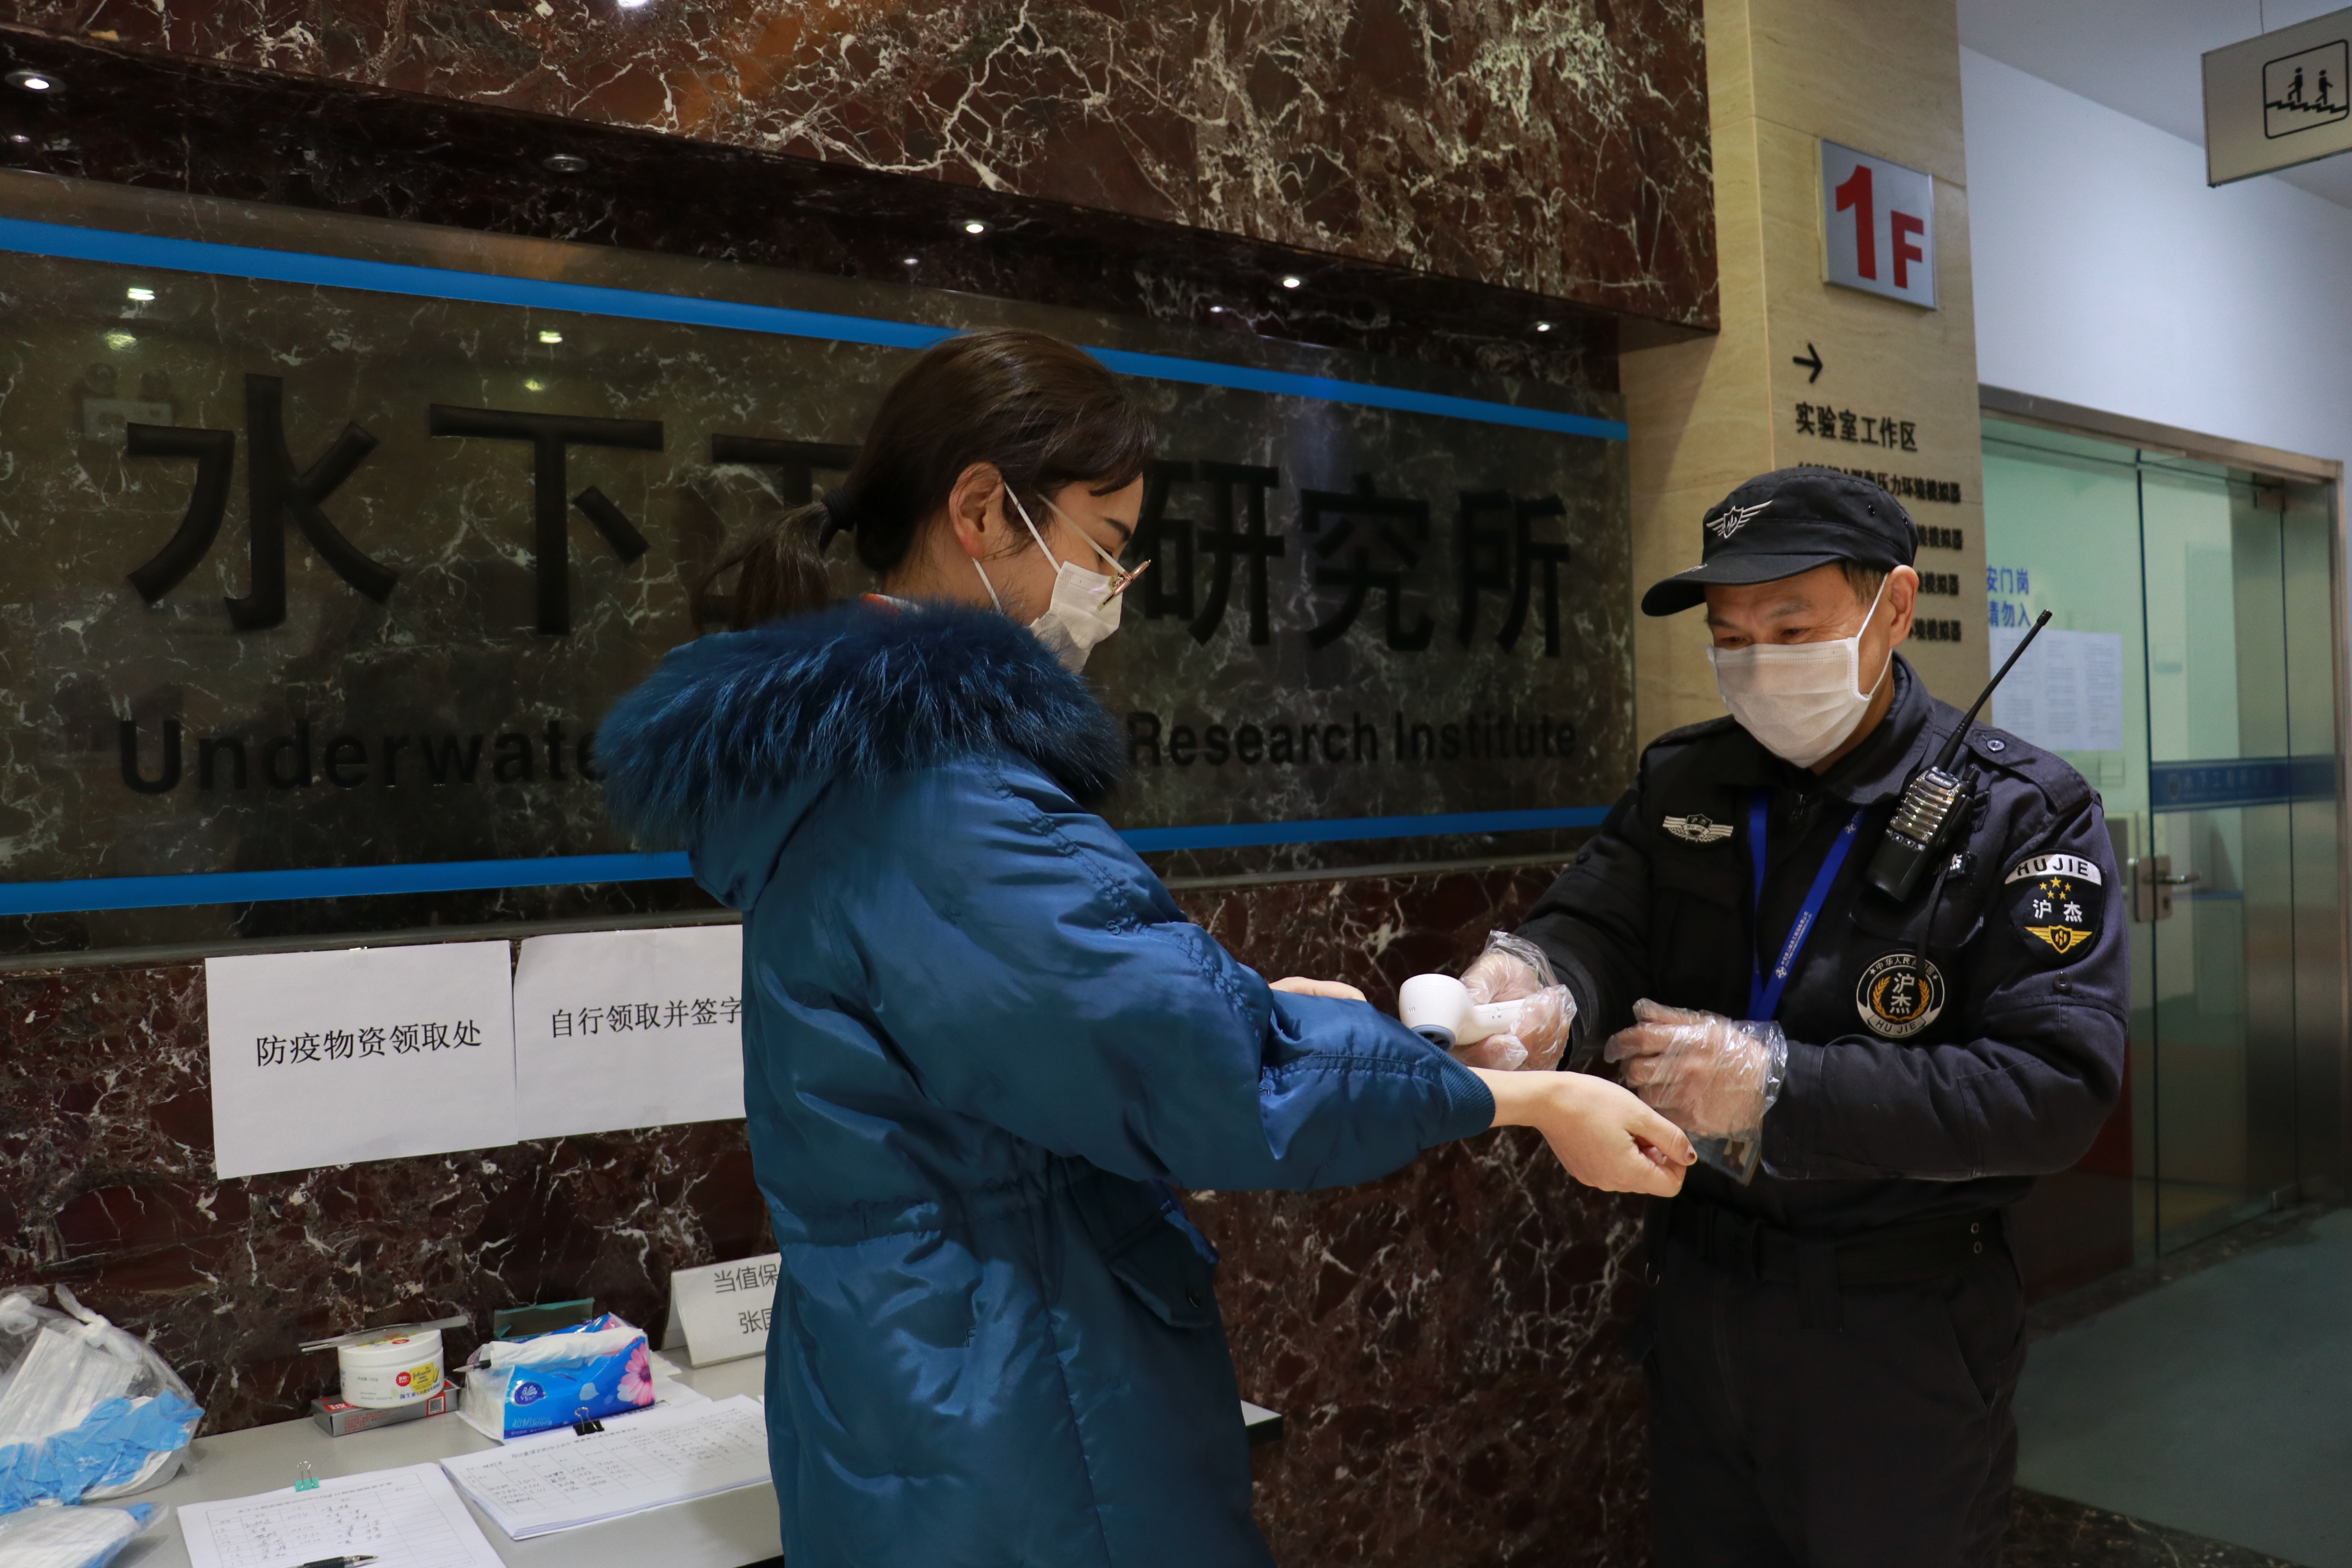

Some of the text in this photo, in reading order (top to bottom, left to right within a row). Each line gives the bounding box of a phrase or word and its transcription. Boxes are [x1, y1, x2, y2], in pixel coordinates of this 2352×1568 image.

[1835, 164, 1925, 289] 1F
[1795, 401, 1918, 452] 实验室工作区
[120, 710, 1577, 796] Underwate Research Institute
[551, 995, 743, 1039] 自行领取并签字
[1889, 972, 1916, 1015] 沪杰
[255, 1019, 483, 1067] 防疫物资领取处
[714, 1263, 779, 1293] 当值保
